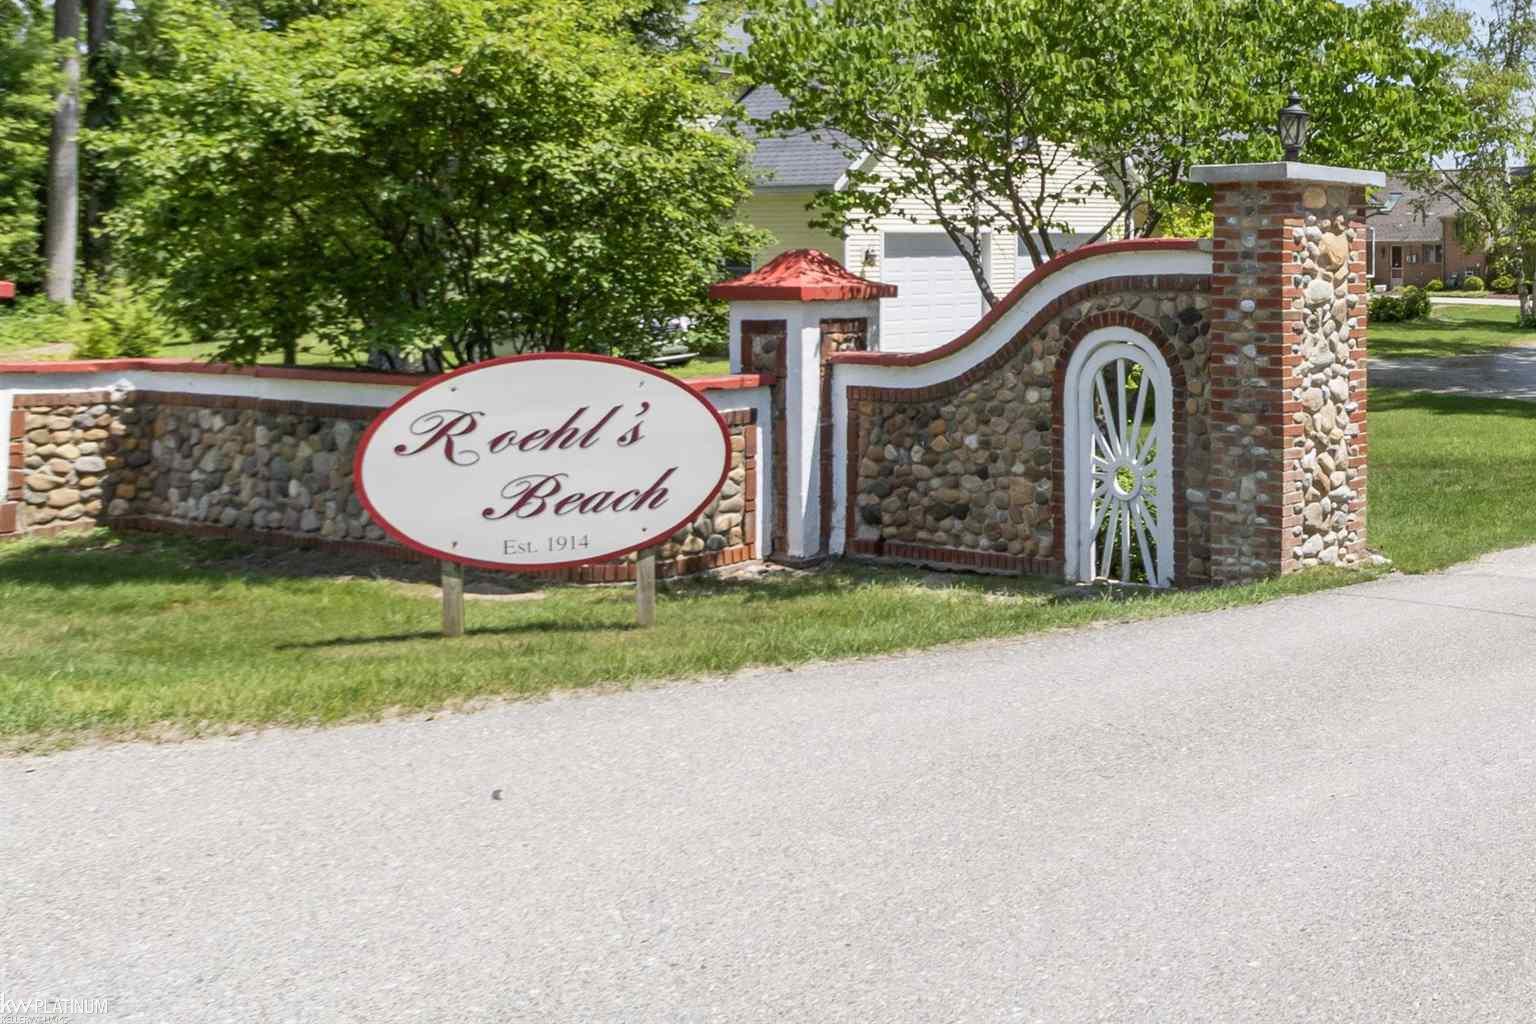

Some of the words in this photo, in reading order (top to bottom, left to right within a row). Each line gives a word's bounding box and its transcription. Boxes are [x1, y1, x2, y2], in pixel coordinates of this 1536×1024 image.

[394, 401, 650, 466] Roehl's
[481, 466, 679, 521] Beach
[503, 539, 538, 555] Est.
[548, 534, 589, 552] 1914
